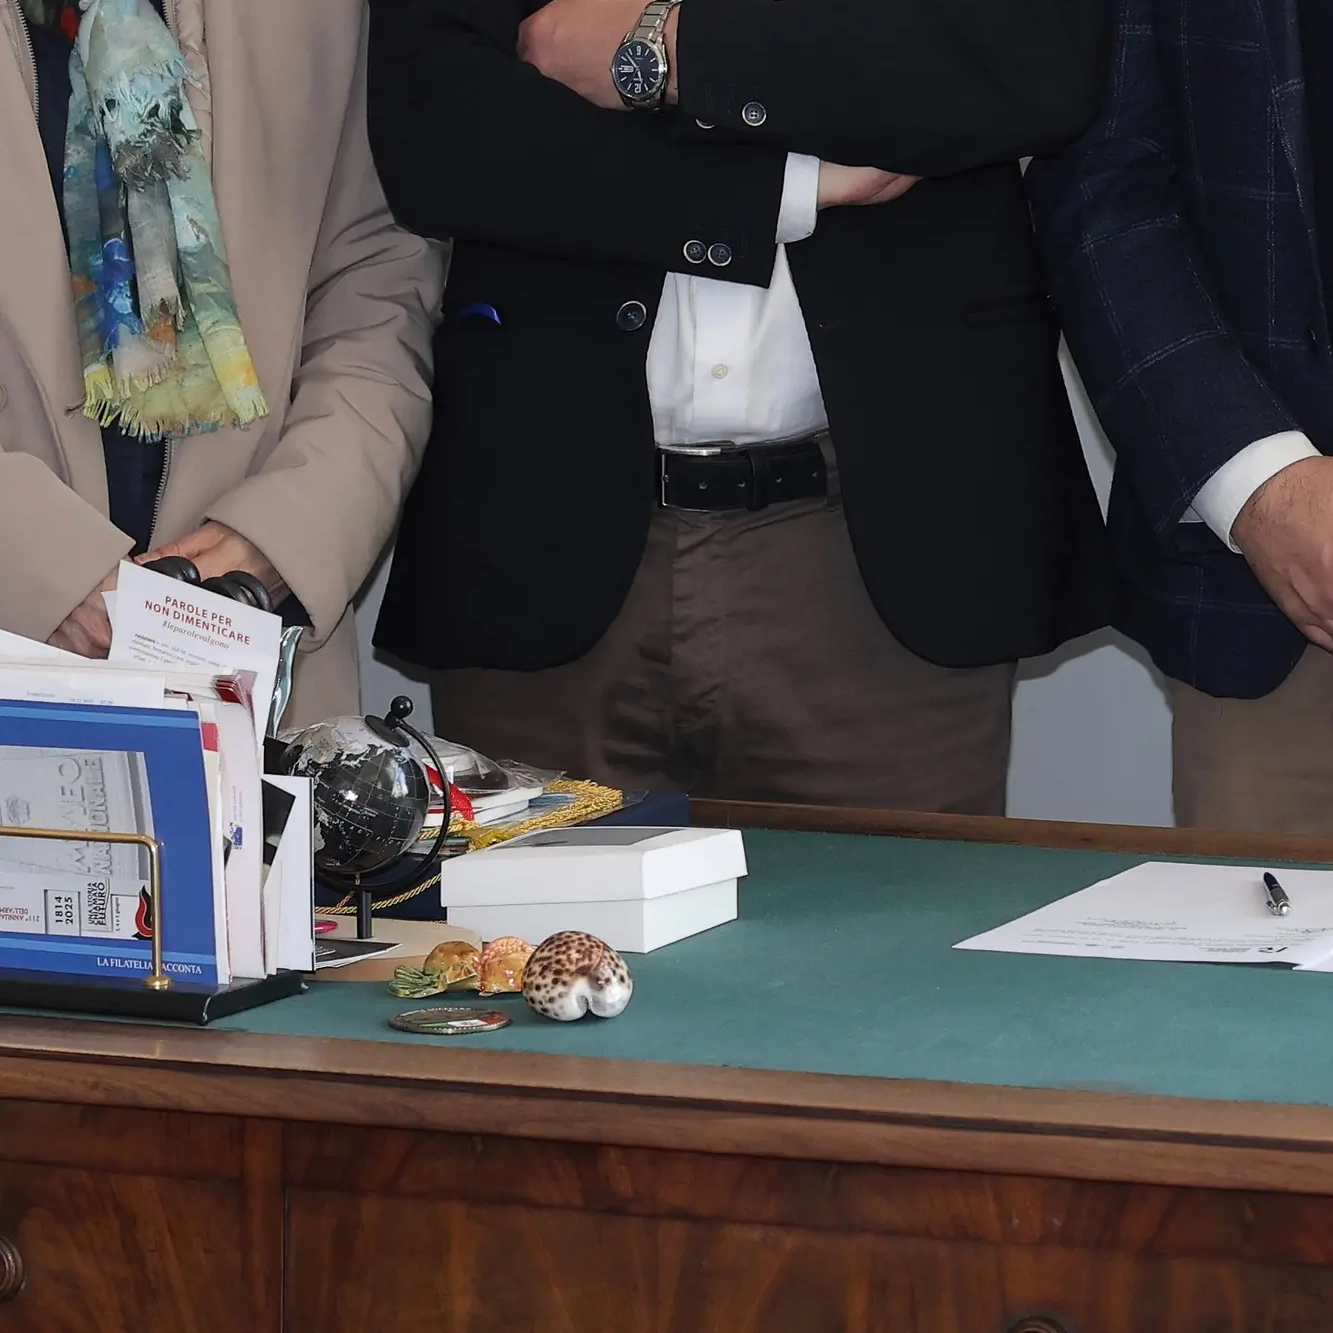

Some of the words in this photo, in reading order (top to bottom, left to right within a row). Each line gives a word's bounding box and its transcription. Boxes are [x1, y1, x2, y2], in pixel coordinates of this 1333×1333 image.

[144, 600, 169, 617] NON
[173, 611, 251, 645] DIMENTICARE
[165, 596, 208, 618] PAROLE
[211, 613, 232, 627] PER
[162, 620, 230, 649] #leparolevalgono
[55, 896, 64, 924] 1814
[65, 896, 74, 925] 2025
[97, 882, 107, 926] FUTURO
[97, 957, 109, 967] LA
[110, 958, 153, 970] FILATELIA
[161, 963, 203, 975] ACCONTA
